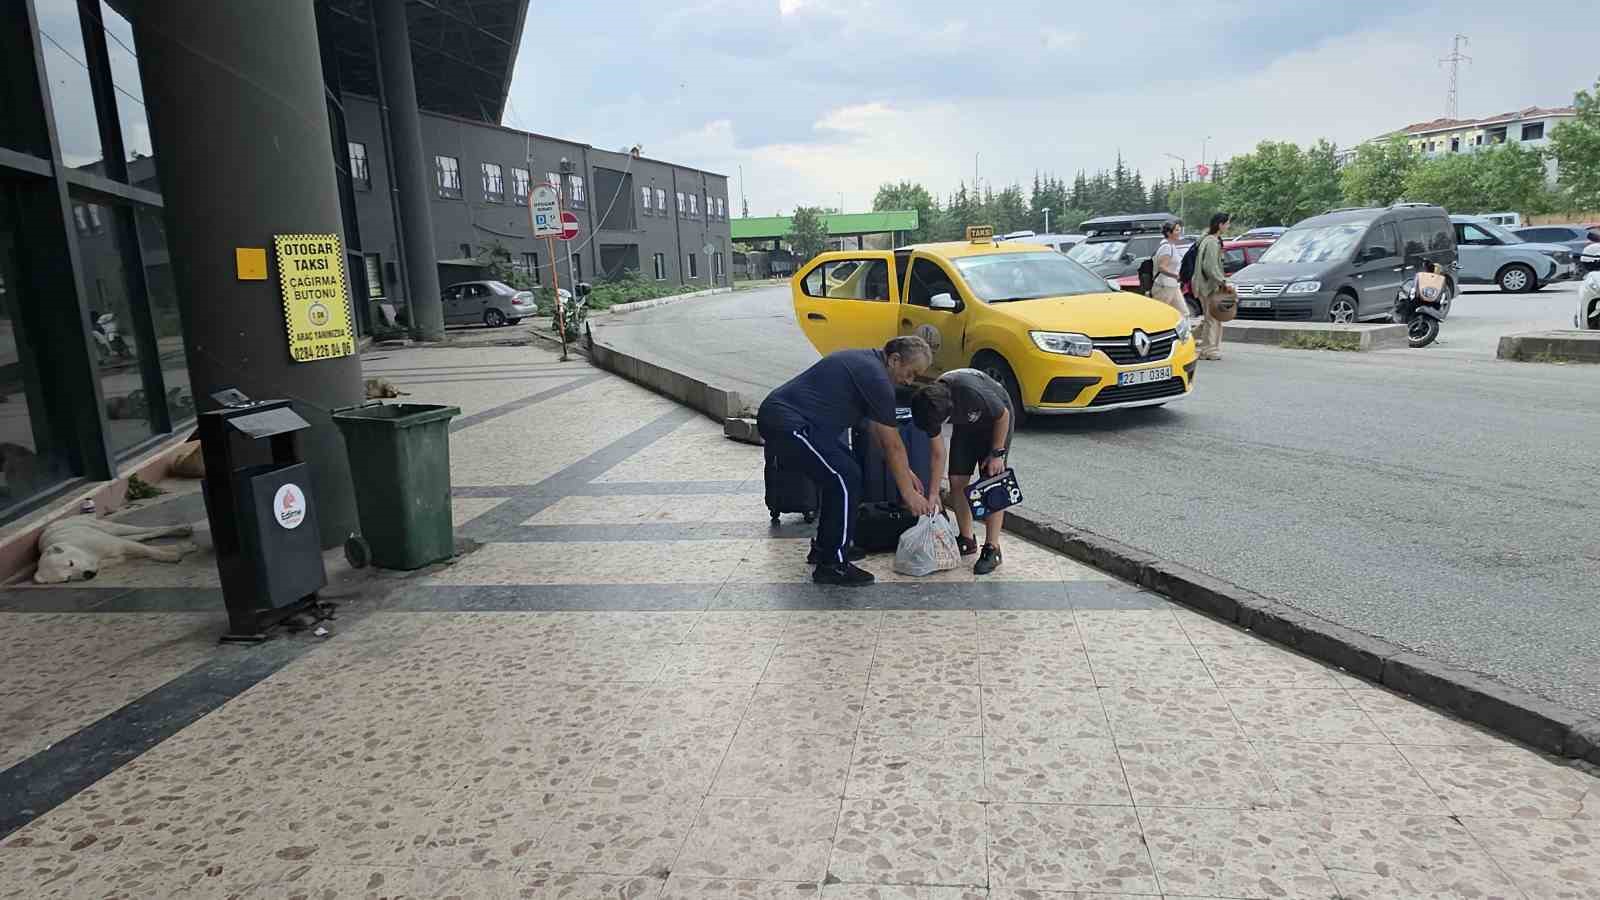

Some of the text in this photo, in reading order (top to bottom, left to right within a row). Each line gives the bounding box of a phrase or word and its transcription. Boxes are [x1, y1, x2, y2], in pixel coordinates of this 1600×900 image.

[284, 243, 333, 256] OTOGAR
[293, 256, 329, 271] TAKSİ
[295, 289, 336, 300] BUTONU
[295, 346, 313, 360] 0284
[331, 343, 340, 356] 04
[1124, 368, 1170, 384] 22 T 0384
